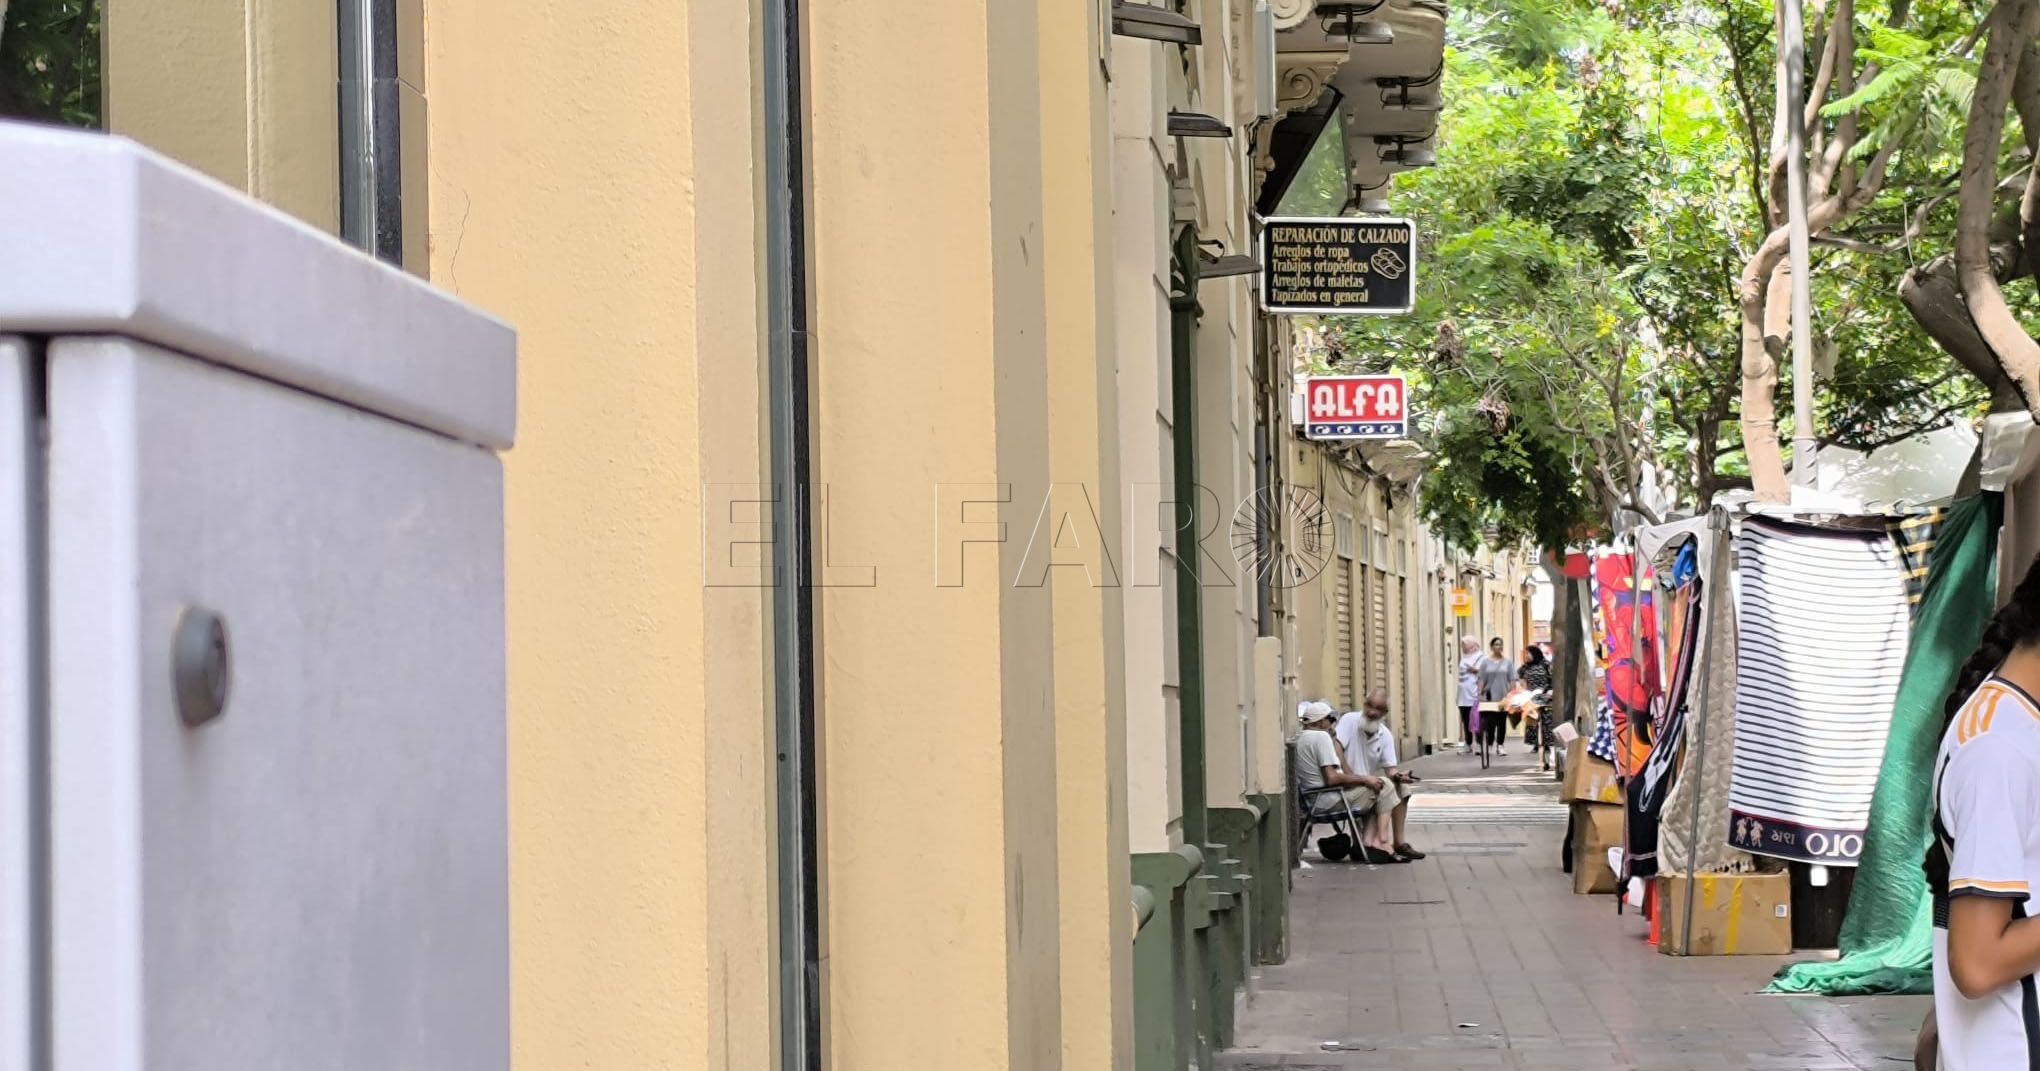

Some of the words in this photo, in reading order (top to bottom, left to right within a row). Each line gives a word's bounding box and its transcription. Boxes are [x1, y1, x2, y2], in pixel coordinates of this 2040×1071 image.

[1272, 225, 1338, 243] REPARACIÓN
[1341, 228, 1356, 243] DE
[1358, 228, 1409, 244] CALZADO
[1272, 244, 1311, 261] Arreglos
[1313, 245, 1325, 257] de
[1327, 247, 1350, 260] ropa
[1272, 259, 1312, 276] Trabajos
[1314, 260, 1369, 275] ortopédicos
[1272, 275, 1311, 291] Arreglos
[1313, 275, 1325, 288] de
[1327, 275, 1364, 288] maletas
[1272, 288, 1317, 304] Tapizados
[1319, 292, 1331, 302] en
[1333, 290, 1369, 306] general
[1312, 384, 1400, 417] ALFA
